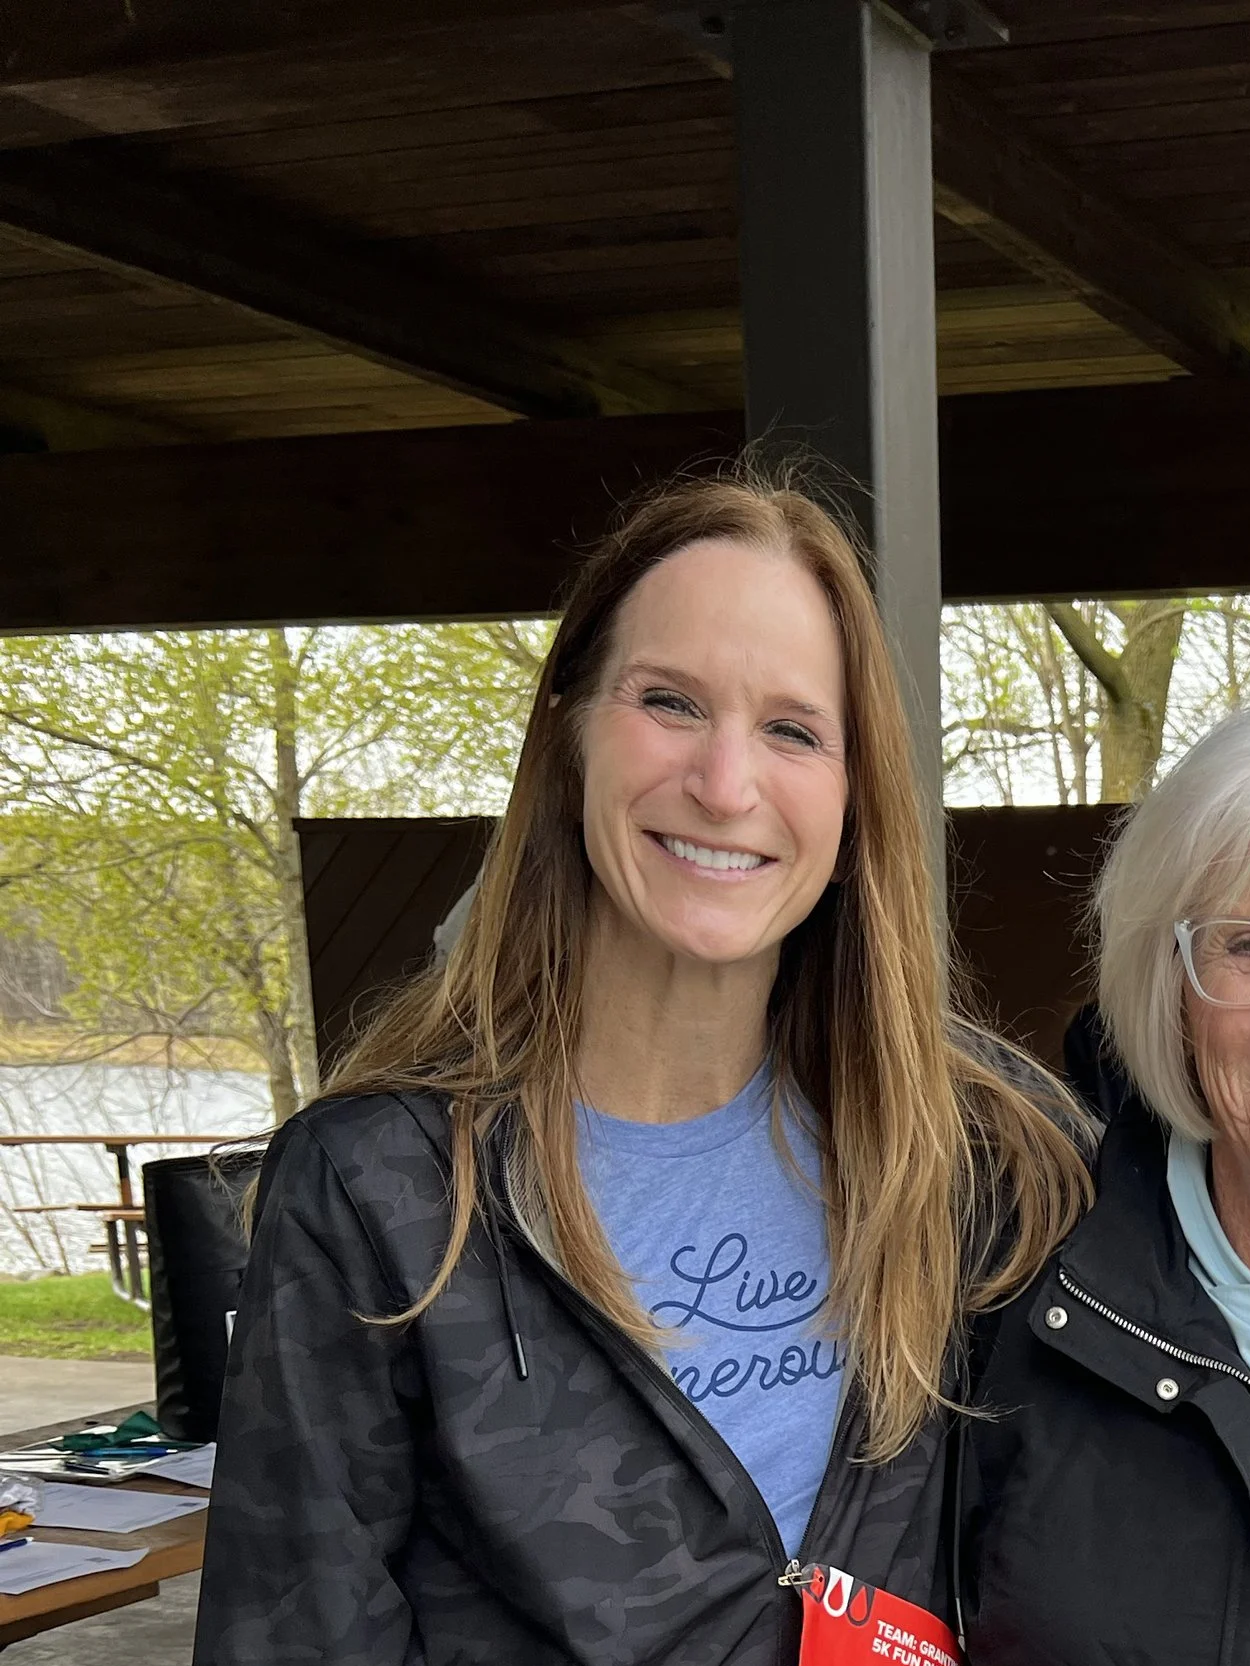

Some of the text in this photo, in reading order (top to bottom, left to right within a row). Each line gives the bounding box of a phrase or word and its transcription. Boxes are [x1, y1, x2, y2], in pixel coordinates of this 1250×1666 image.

[649, 1233, 830, 1332] Live
[871, 1637, 892, 1658] 5K
[877, 1619, 918, 1651] TEAM:
